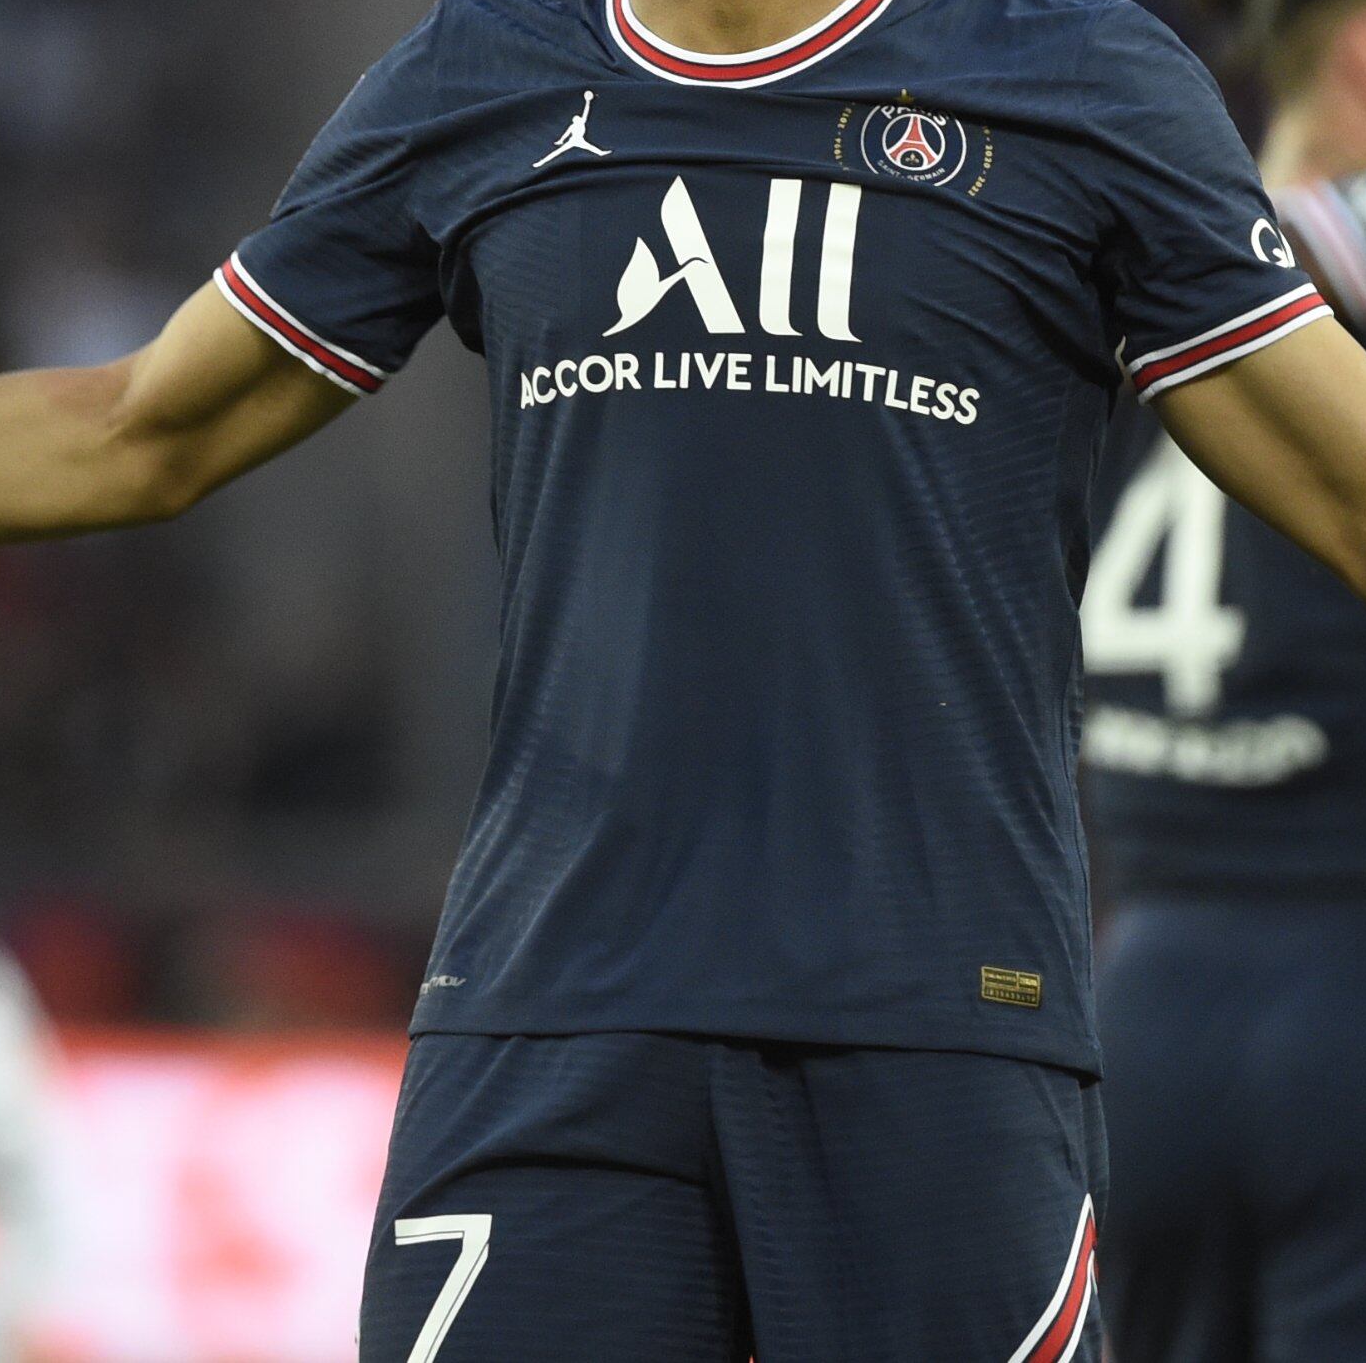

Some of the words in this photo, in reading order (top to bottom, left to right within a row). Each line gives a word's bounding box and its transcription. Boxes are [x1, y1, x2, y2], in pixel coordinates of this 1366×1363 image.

[521, 352, 642, 410] ACCOR
[654, 352, 752, 390] LIVE
[765, 354, 980, 425] LIMITLESS
[1079, 432, 1248, 720] 4
[395, 1214, 492, 1363] 7
